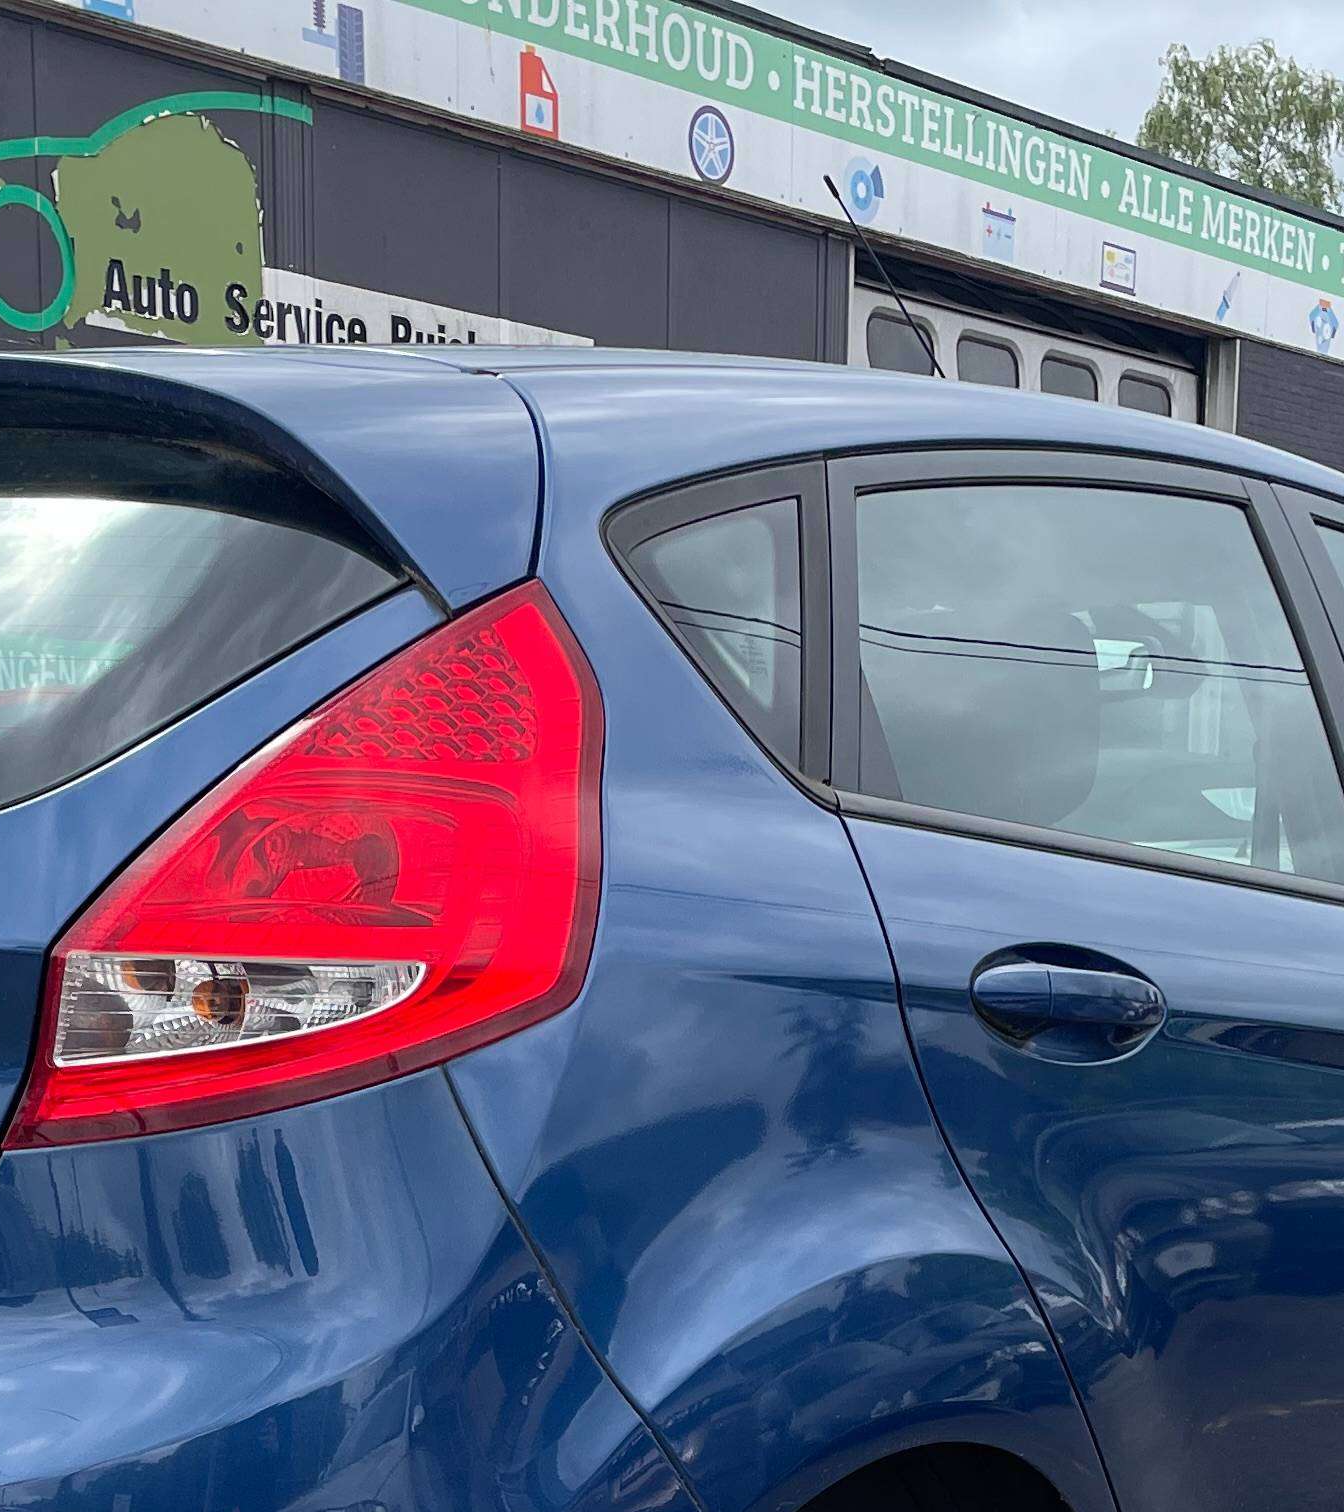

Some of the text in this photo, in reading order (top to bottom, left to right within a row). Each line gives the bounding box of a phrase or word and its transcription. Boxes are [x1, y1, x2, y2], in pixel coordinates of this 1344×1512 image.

[793, 55, 1092, 201] HERSTELLINGEN
[1118, 168, 1194, 234] ALLE
[1200, 195, 1316, 274] MERKEN
[102, 257, 199, 324] Auto
[225, 282, 367, 344] Service
